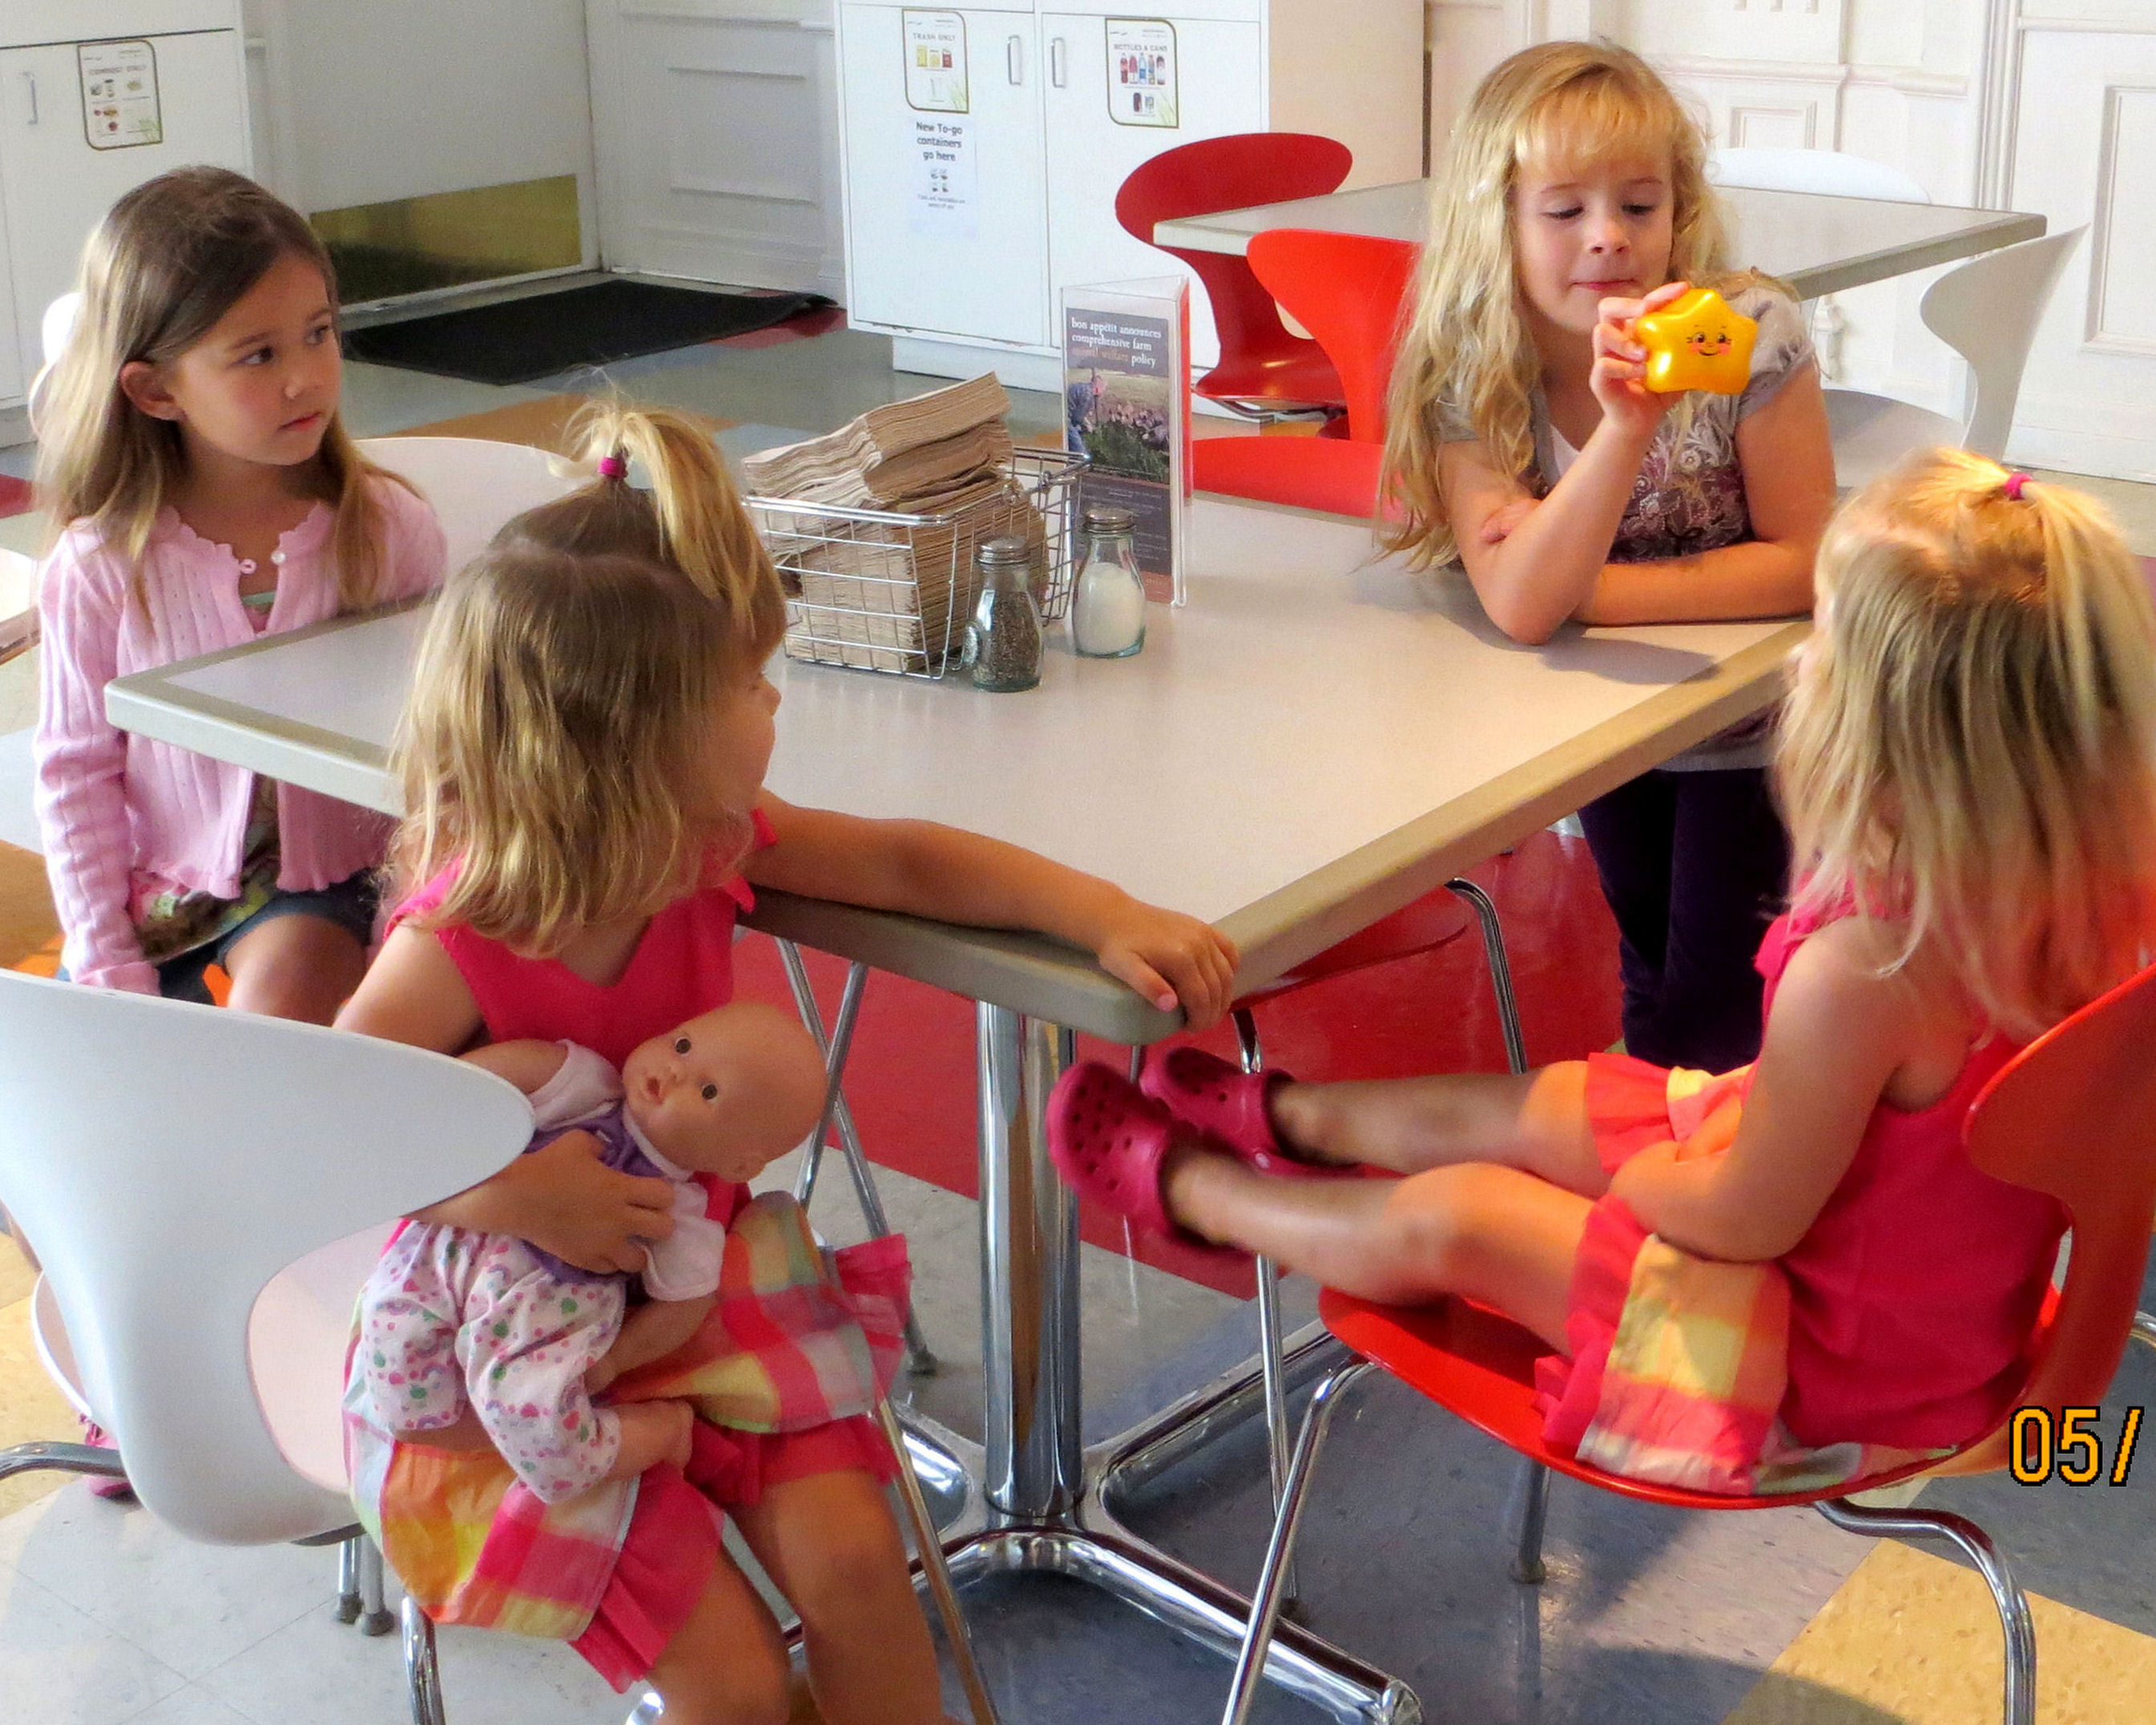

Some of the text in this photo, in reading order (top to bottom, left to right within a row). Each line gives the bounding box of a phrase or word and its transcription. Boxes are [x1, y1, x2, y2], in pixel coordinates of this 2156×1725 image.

[916, 121, 963, 136] New To-go
[917, 137, 962, 148] containers
[923, 151, 956, 161] go here
[1071, 316, 1087, 329] bon
[1119, 326, 1162, 339] announces
[1071, 334, 1152, 351] comprehensive farm
[1130, 353, 1157, 369] policy
